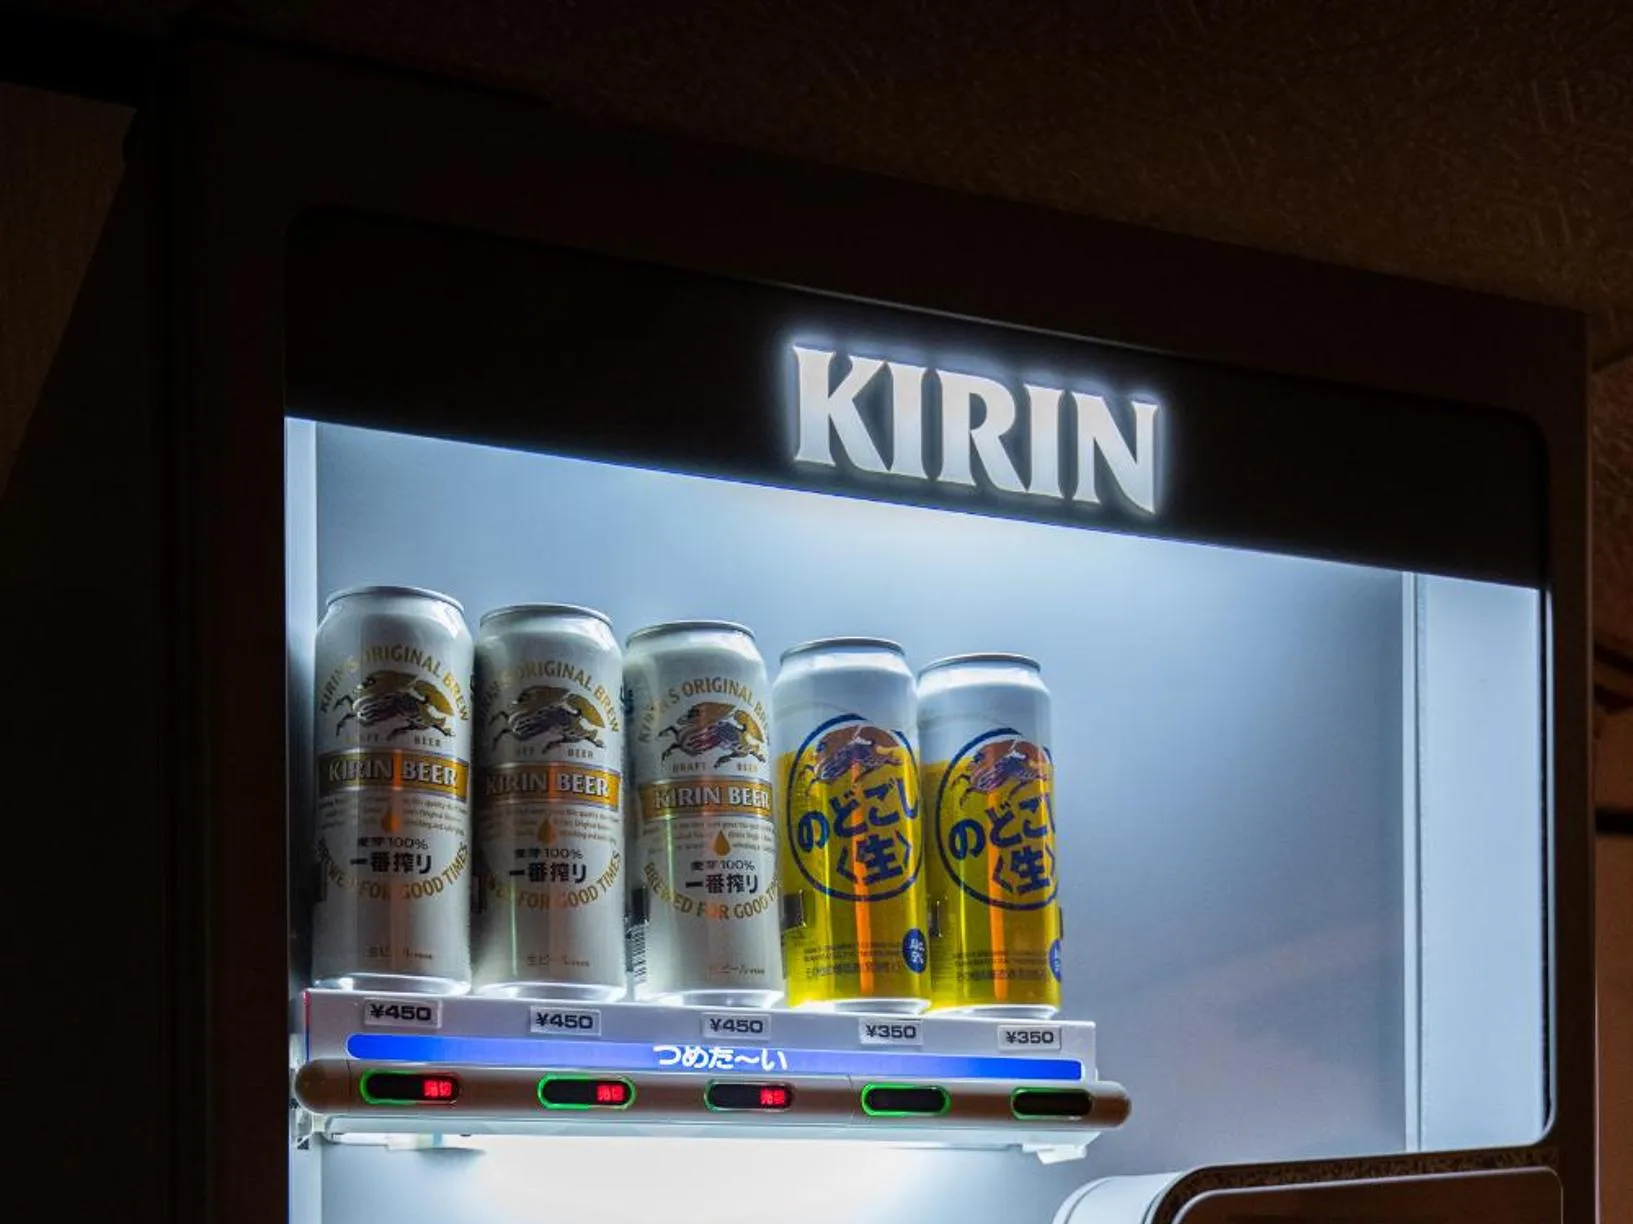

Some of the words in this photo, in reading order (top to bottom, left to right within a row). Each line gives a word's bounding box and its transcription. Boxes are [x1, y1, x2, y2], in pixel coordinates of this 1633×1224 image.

[793, 346, 1159, 513] KIRIN
[682, 677, 754, 706] ORIGINAL
[414, 735, 441, 747] BEER
[567, 748, 594, 759] BEER
[329, 759, 392, 782] KIRIN
[403, 761, 458, 786] BEER
[486, 773, 547, 796] KIRIN
[557, 773, 609, 798] BEER
[654, 787, 721, 809] KIRIN
[728, 787, 770, 810] BEER
[796, 778, 919, 854] のどごし
[351, 851, 432, 875] 一番搾り
[509, 862, 587, 884] 一番搾り
[400, 877, 444, 900] GOOD
[685, 874, 759, 895] 一番搾り
[734, 896, 769, 920] GOOD
[370, 1004, 432, 1022] ¥450
[536, 1012, 594, 1029] ¥450
[710, 1018, 764, 1034] ¥450
[866, 1024, 917, 1040] ¥350
[1005, 1030, 1054, 1045] ¥350
